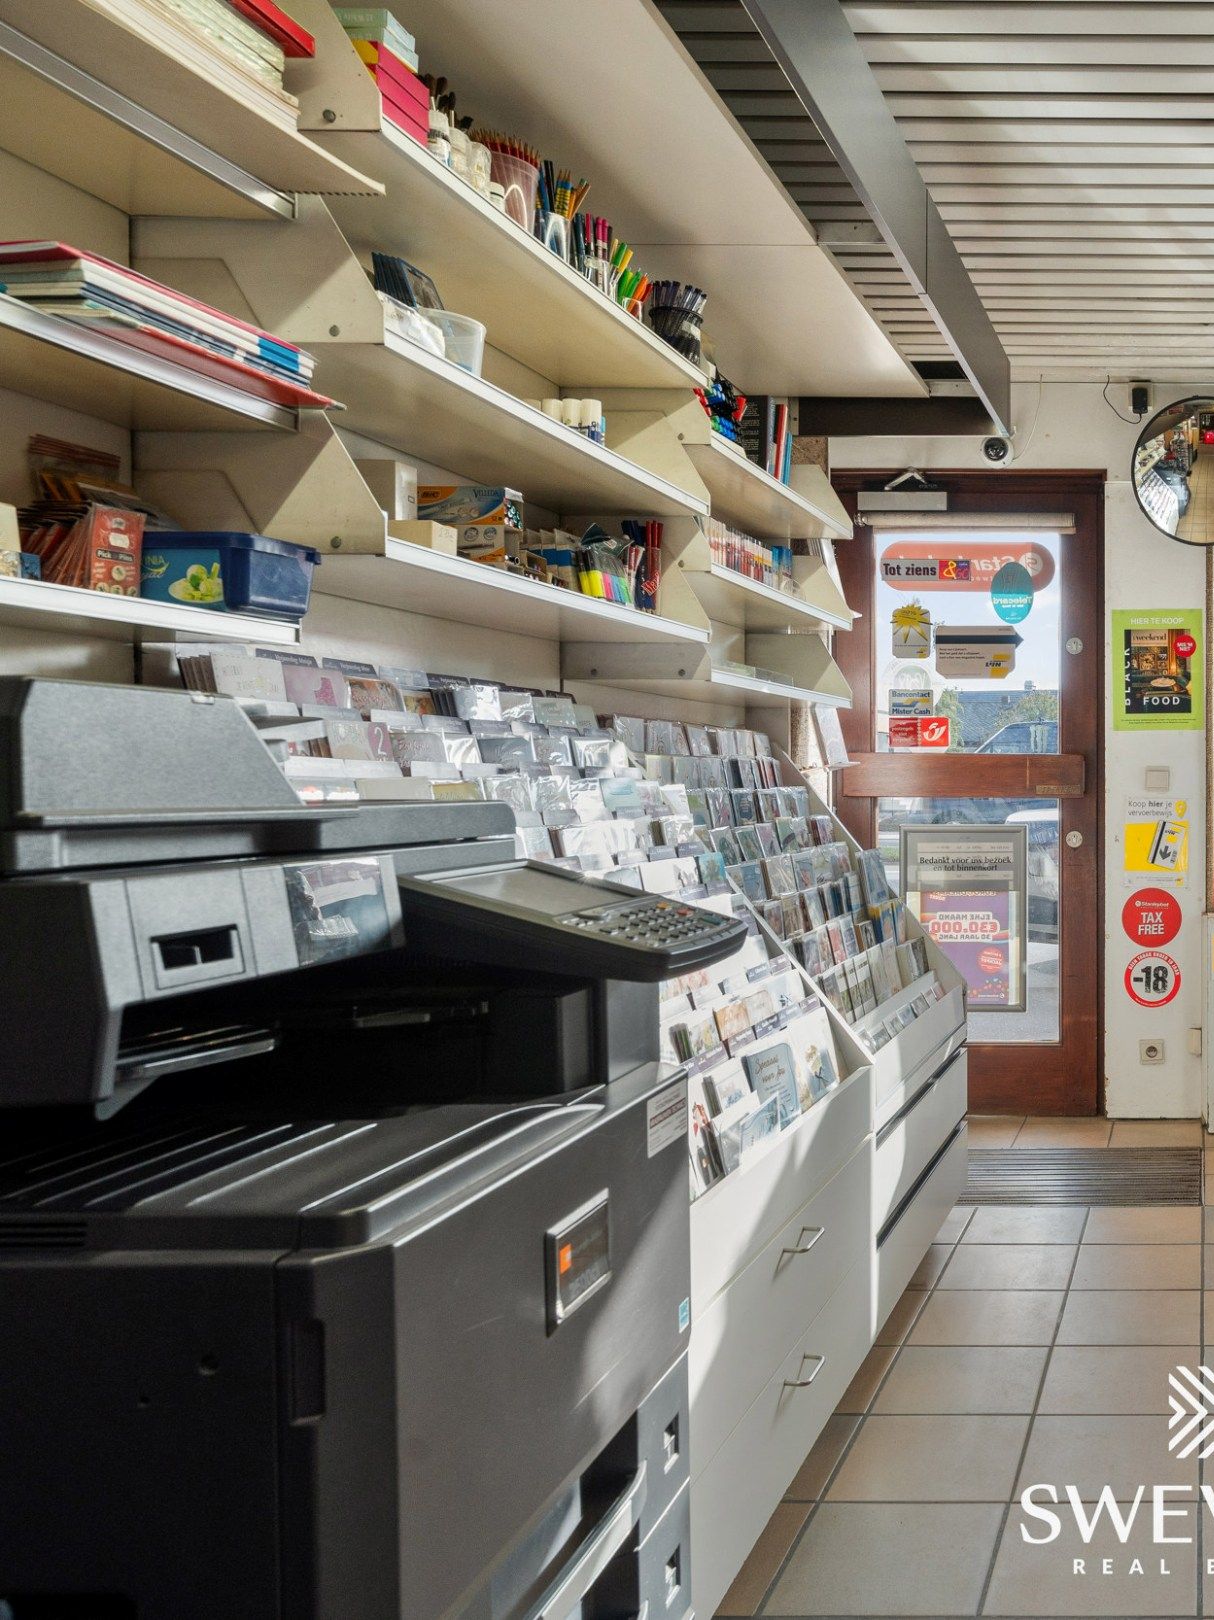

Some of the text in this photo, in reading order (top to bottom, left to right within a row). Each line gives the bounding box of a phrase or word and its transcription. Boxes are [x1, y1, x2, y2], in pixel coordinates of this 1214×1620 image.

[883, 563, 937, 577] Tot ziens
[1131, 617, 1149, 625] HIER
[1163, 617, 1184, 625] KOOP
[892, 690, 931, 698] Bancontact
[1143, 696, 1181, 706] FOOD
[892, 707, 931, 716] Mister Cash
[1128, 800, 1147, 809] Koop
[1165, 801, 1173, 809] je
[919, 856, 950, 864] Bedankt
[984, 855, 1012, 865] bezoek
[944, 864, 956, 872] tot
[956, 864, 998, 872] binnenkort
[1140, 911, 1163, 924] TAX
[1137, 923, 1165, 936] FREE
[1133, 965, 1169, 994] -18
